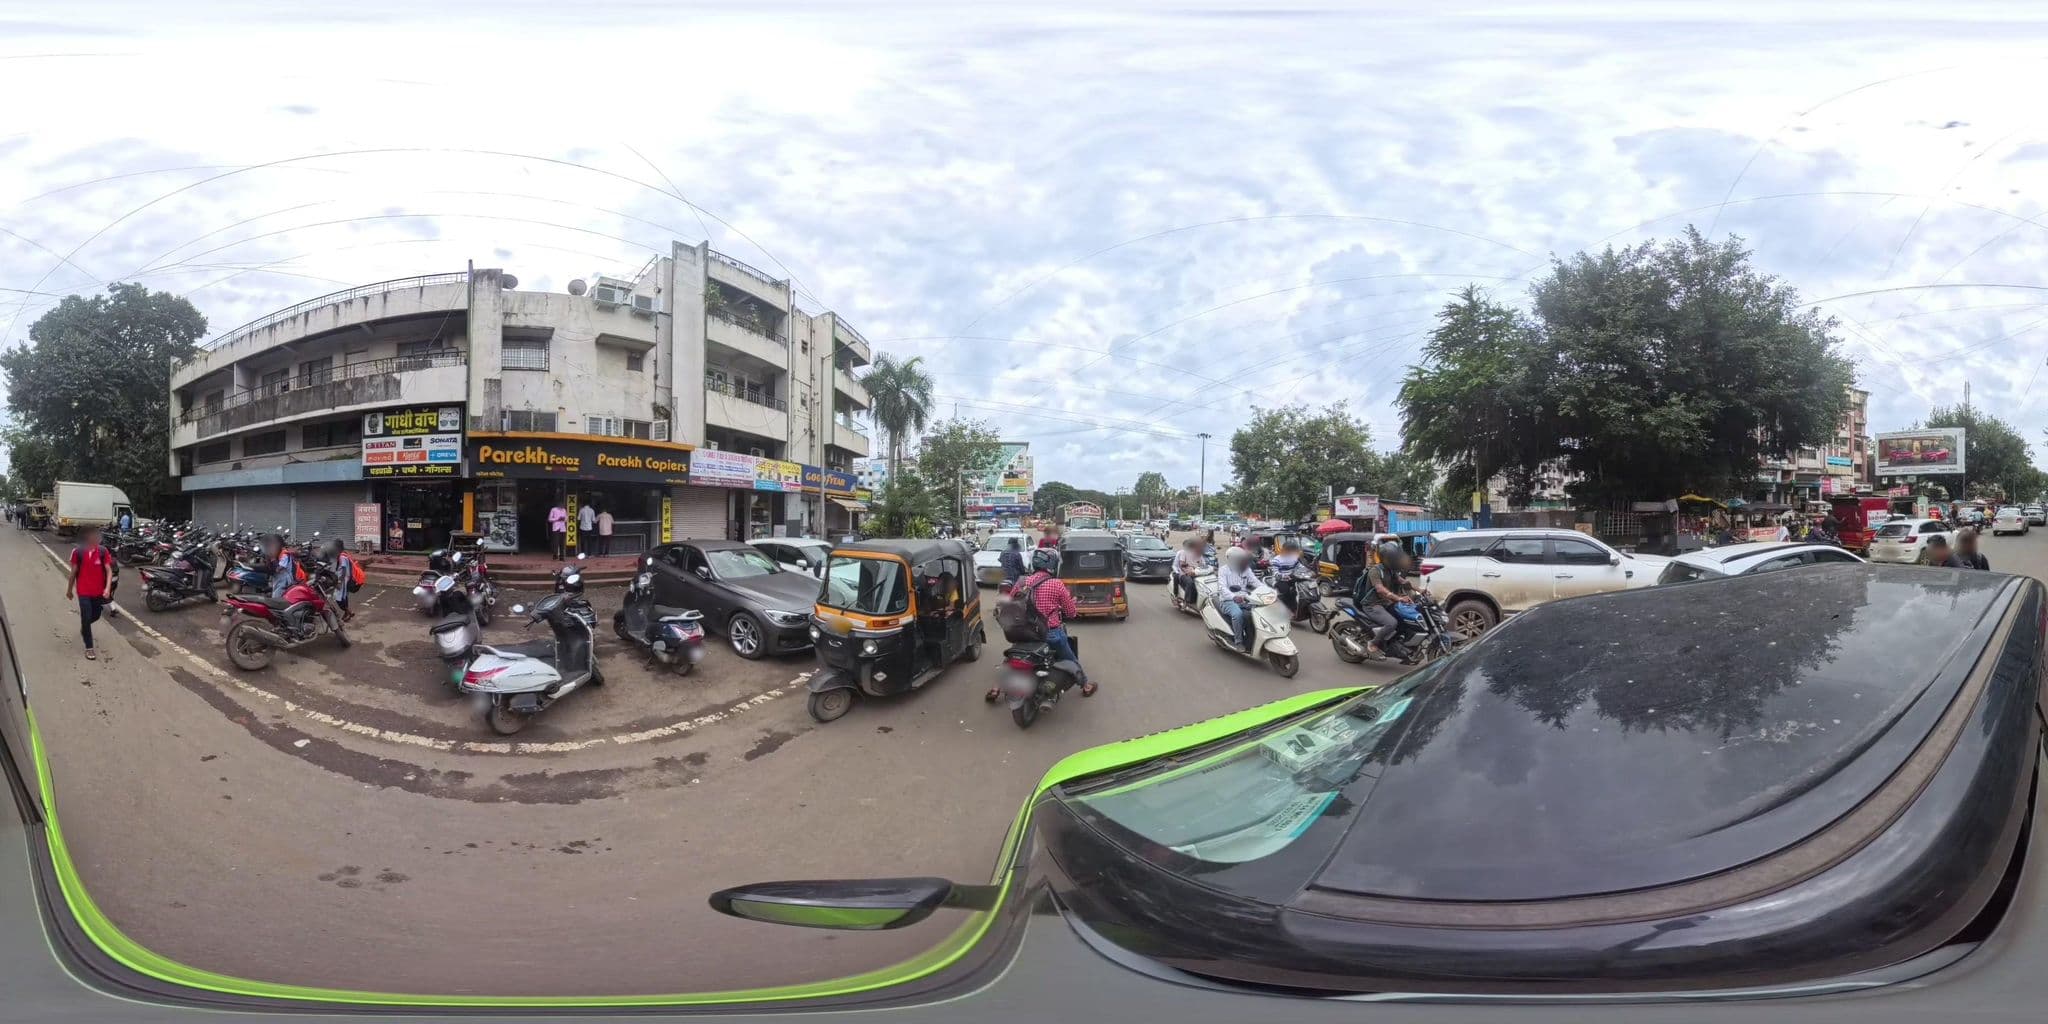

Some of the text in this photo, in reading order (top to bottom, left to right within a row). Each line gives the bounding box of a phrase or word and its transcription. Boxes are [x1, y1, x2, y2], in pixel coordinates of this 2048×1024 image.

[384, 408, 438, 429] गांधी वॉच
[480, 445, 548, 464] Parekh
[597, 453, 642, 468] Parekh
[645, 456, 687, 472] Copiers
[568, 495, 576, 542] XEROX
